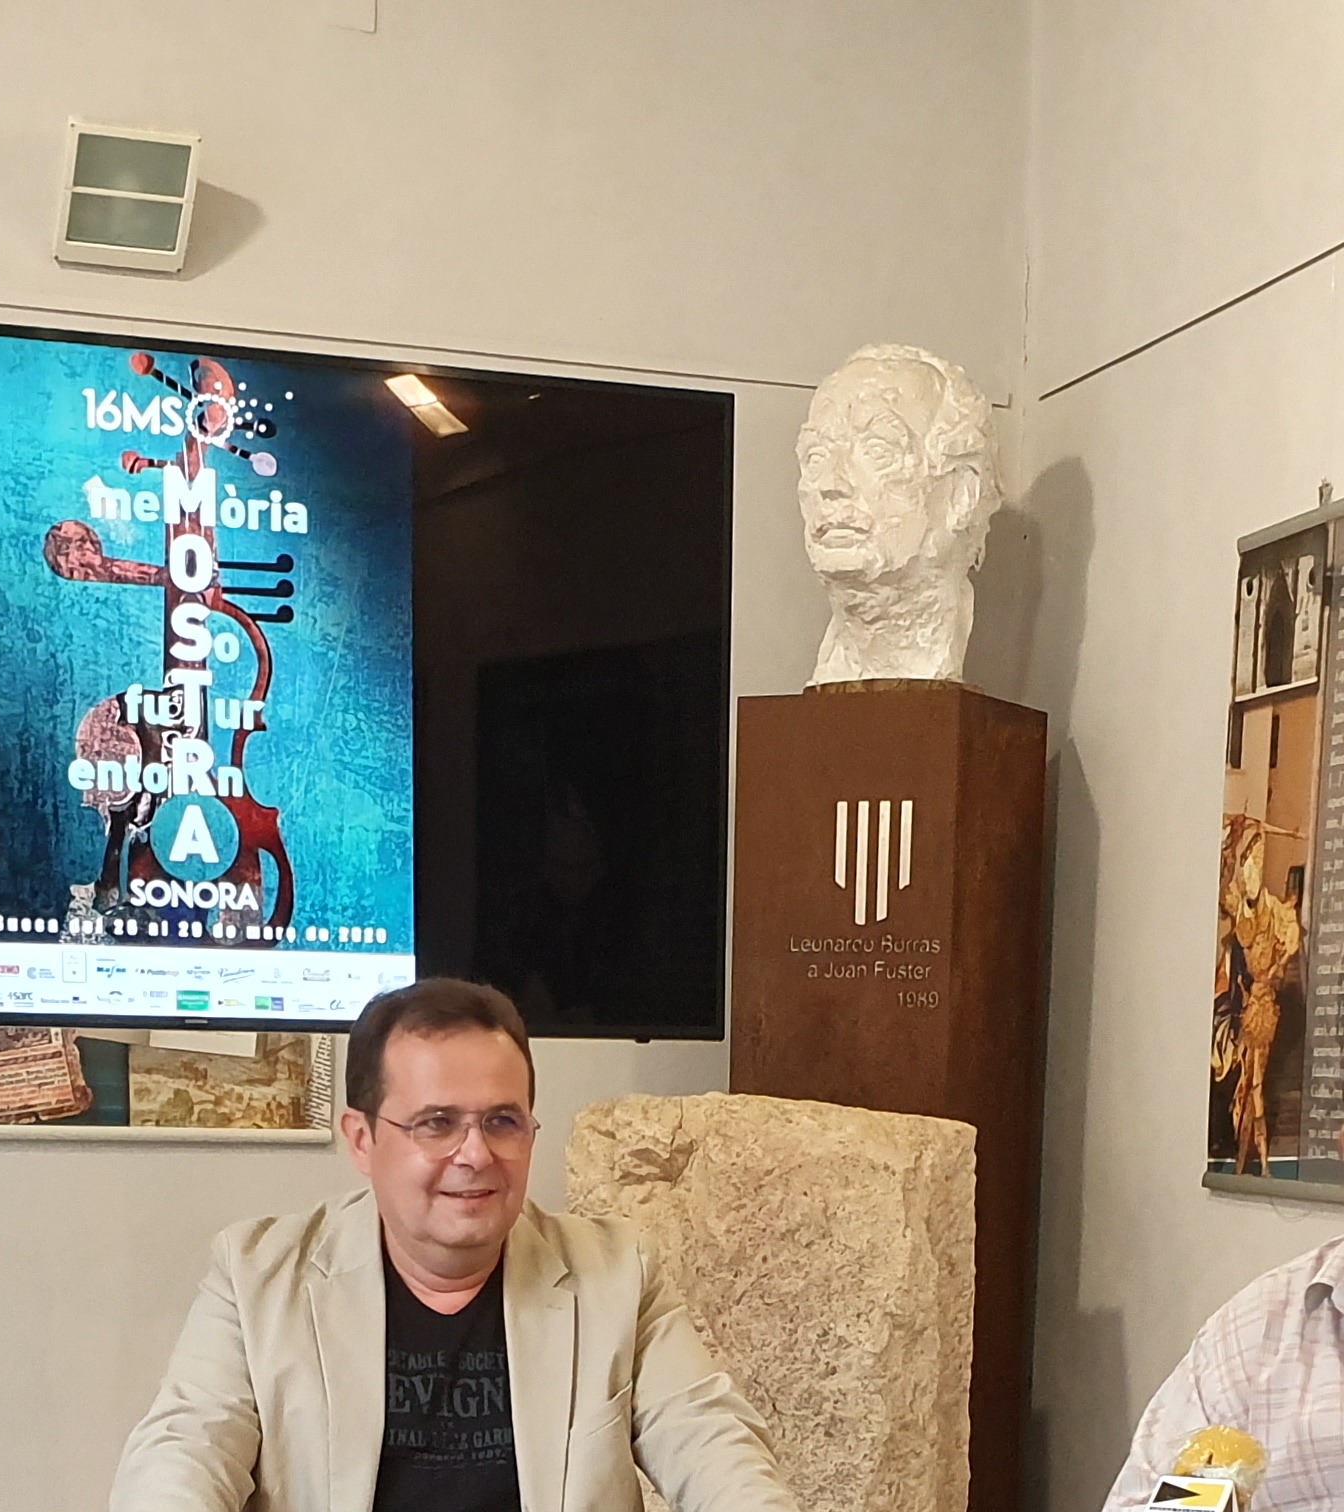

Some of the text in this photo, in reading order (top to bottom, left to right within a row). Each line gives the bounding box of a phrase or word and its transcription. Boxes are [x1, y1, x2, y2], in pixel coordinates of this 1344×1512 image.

[130, 879, 259, 911] SONORA
[808, 963, 818, 978] a
[874, 960, 931, 980] Fuster
